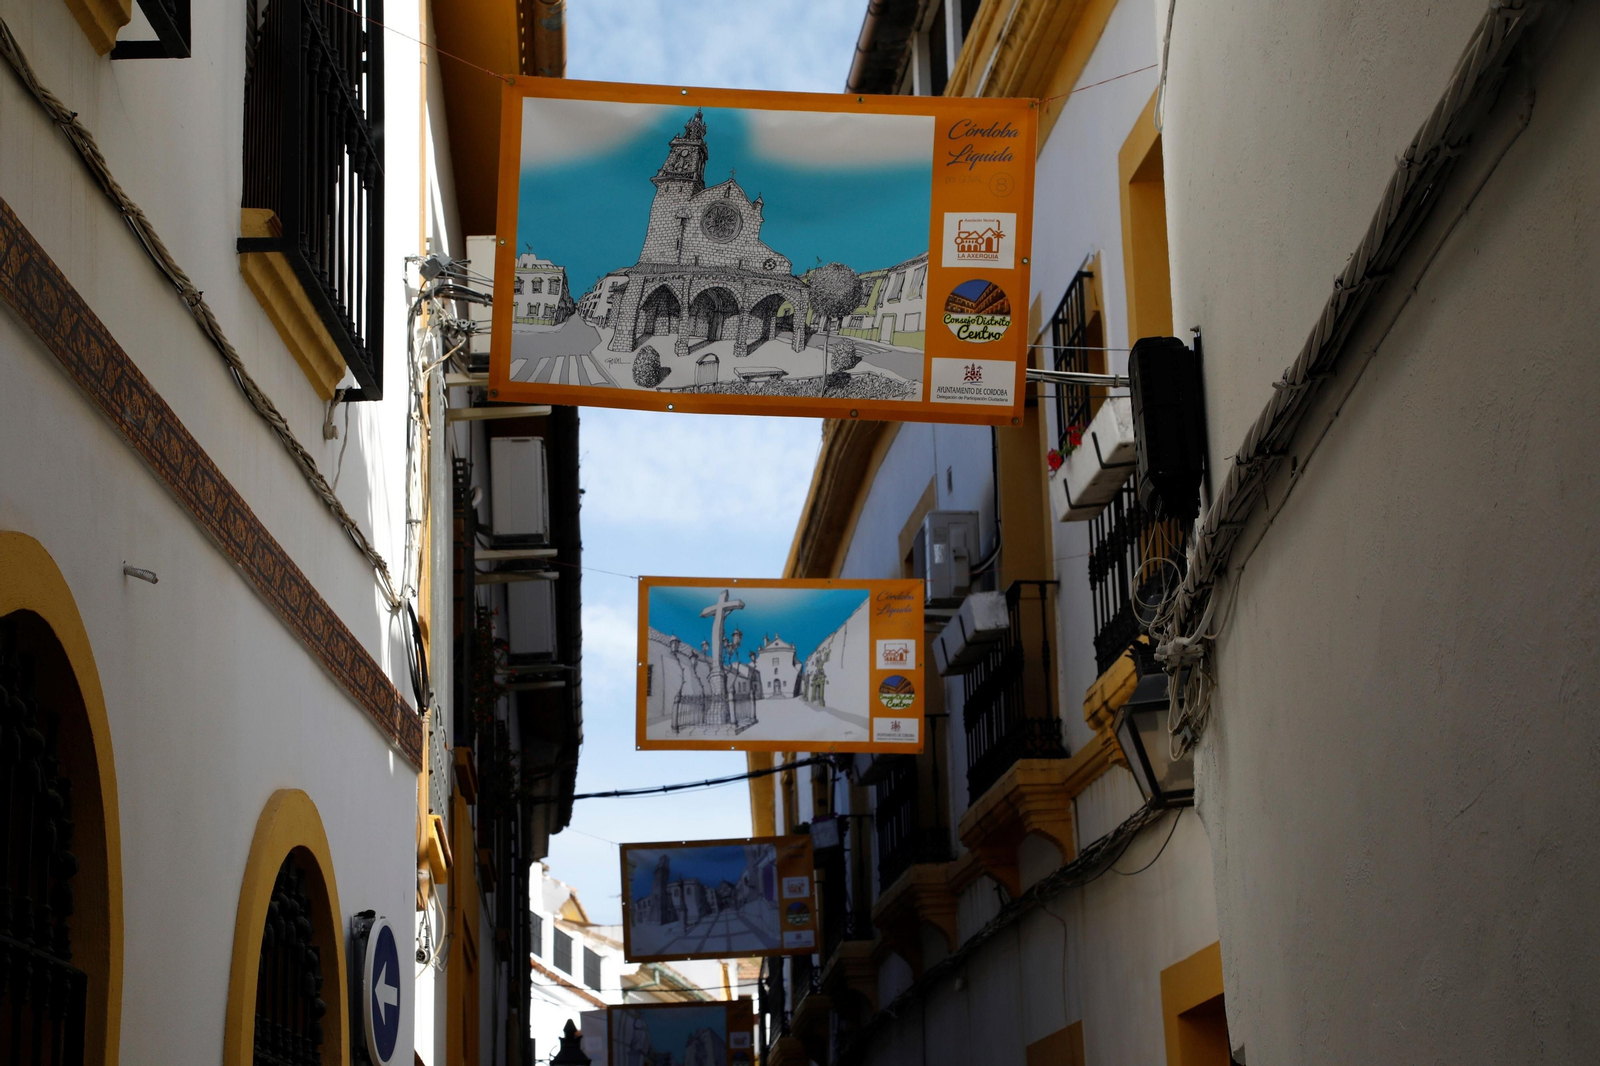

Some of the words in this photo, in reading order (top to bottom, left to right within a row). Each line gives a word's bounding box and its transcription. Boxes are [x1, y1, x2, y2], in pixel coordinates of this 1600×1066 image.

[948, 118, 1018, 140] Córdoba
[943, 313, 975, 326] Consejo
[975, 315, 1011, 327] Distrito
[956, 324, 1003, 340] Centro
[936, 386, 975, 395] AYUNTAMIENTO
